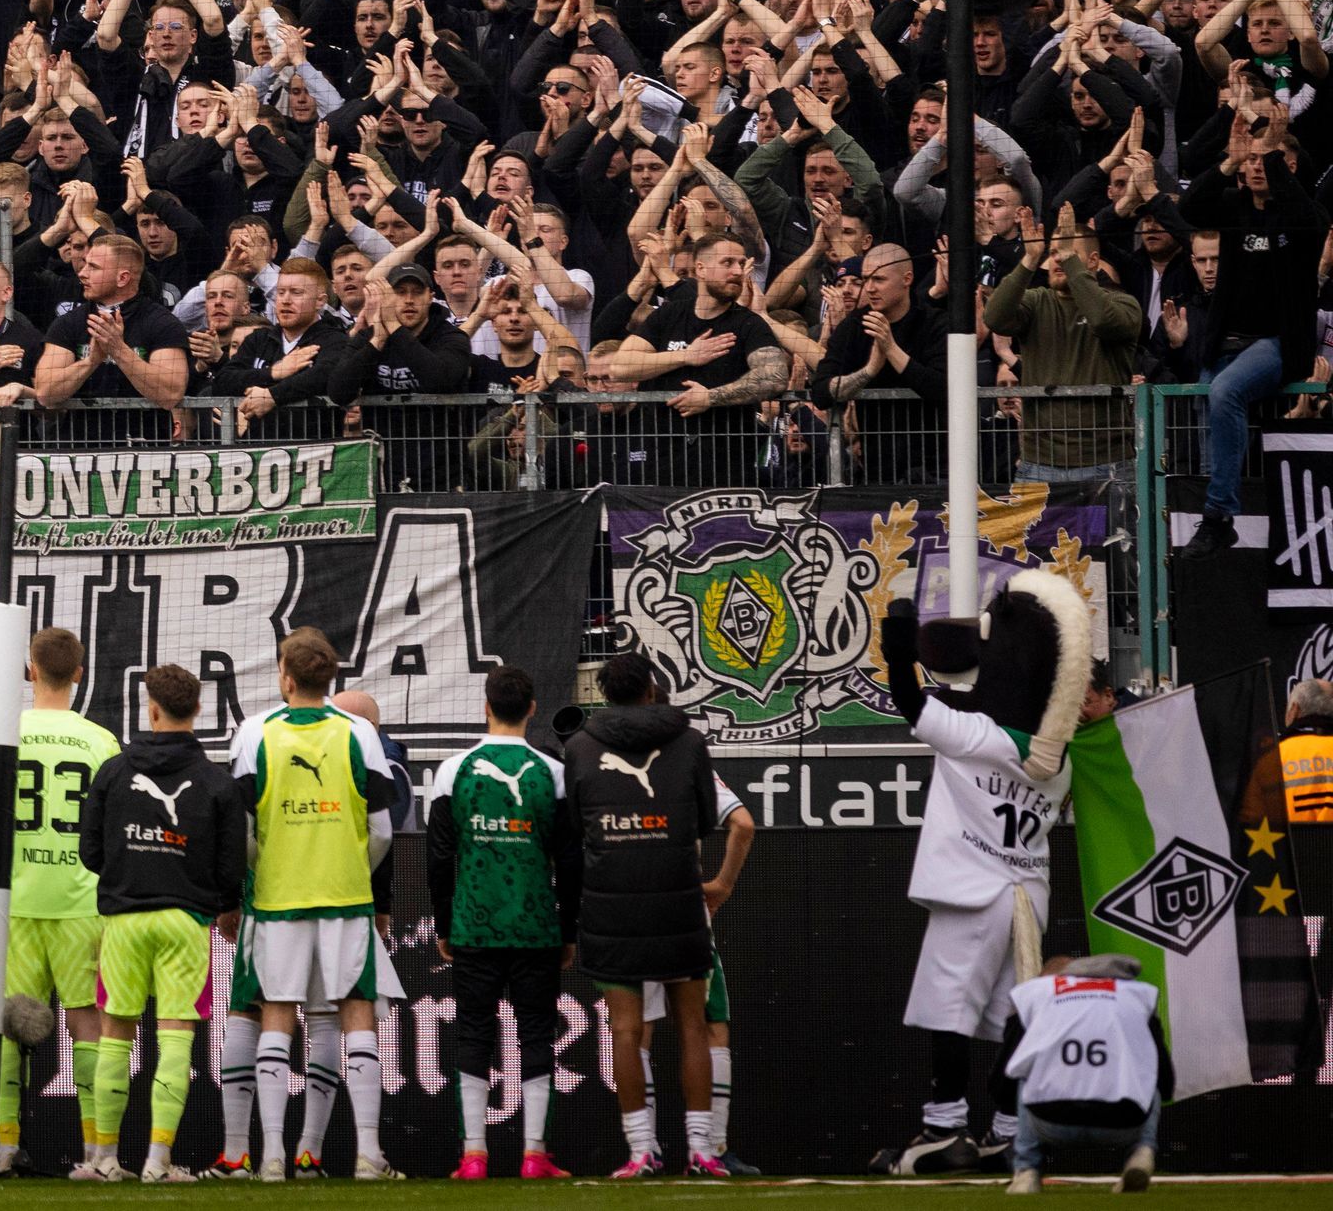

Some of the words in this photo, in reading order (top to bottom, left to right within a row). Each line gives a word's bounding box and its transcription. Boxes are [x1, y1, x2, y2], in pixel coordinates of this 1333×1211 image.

[681, 494, 753, 523] NORD
[15, 759, 93, 836] 33
[281, 798, 341, 815] flatex
[470, 814, 533, 833] flatex
[599, 813, 668, 831] flatex
[992, 802, 1041, 852] 10
[123, 823, 189, 847] flatex
[22, 847, 78, 866] NICOLAS
[1061, 1038, 1108, 1067] 06
